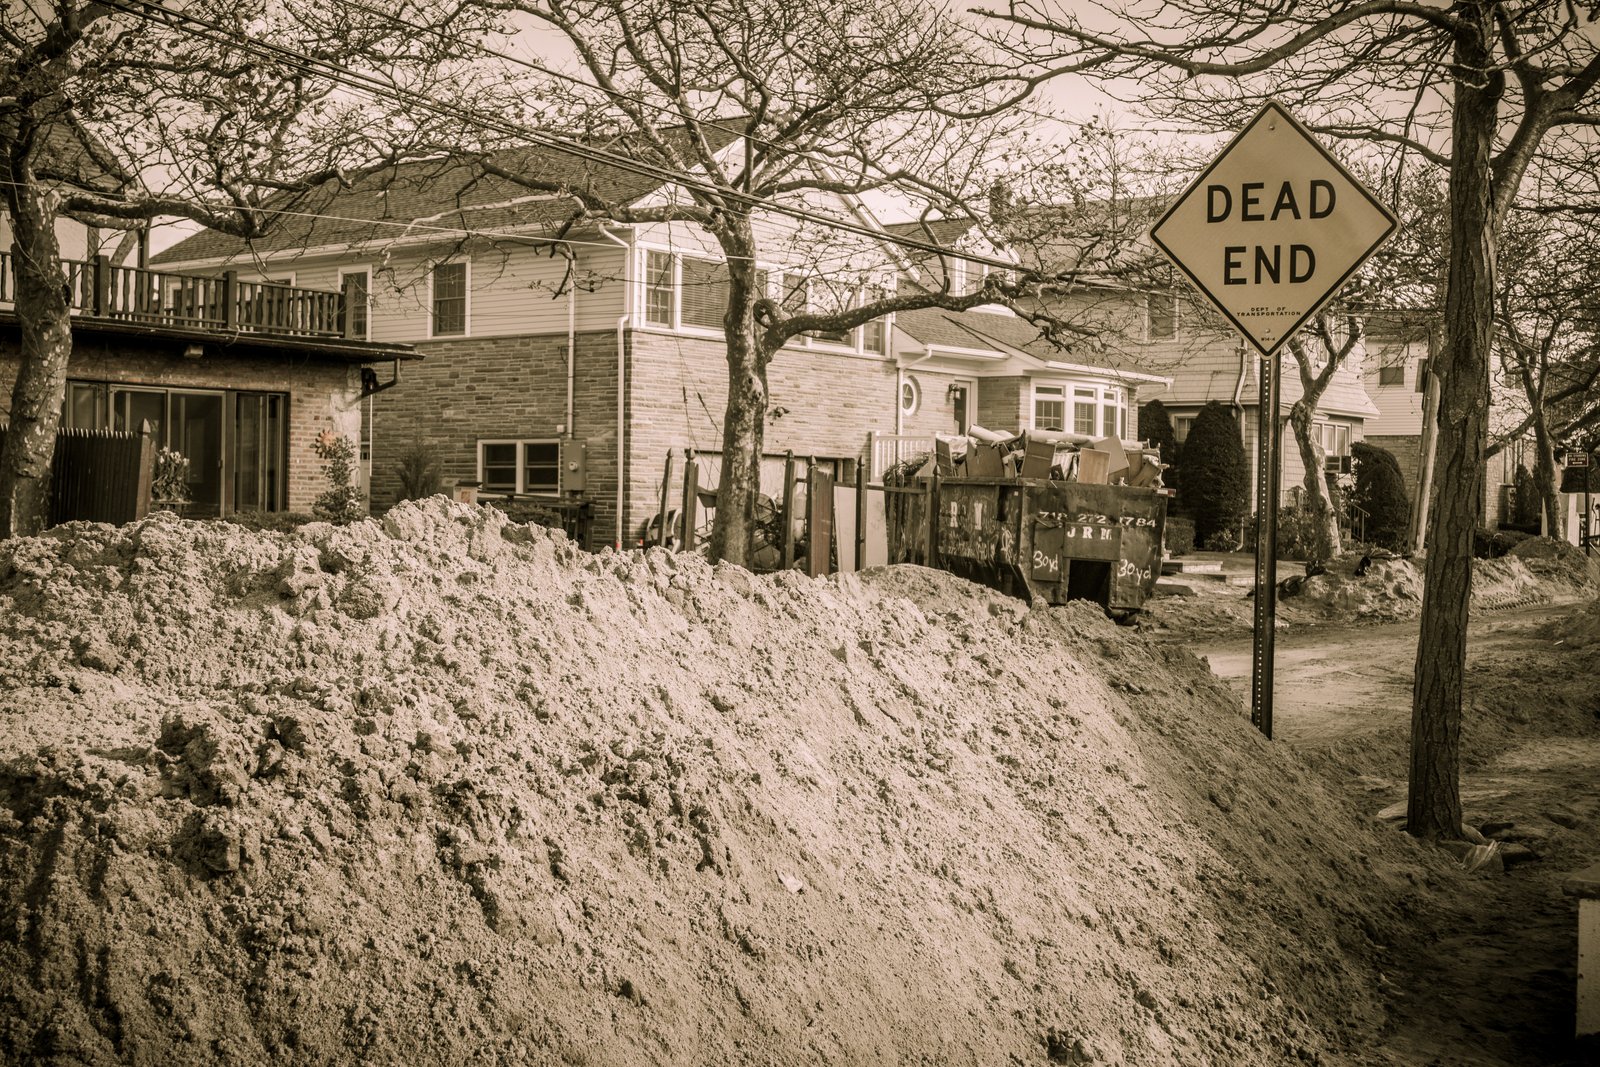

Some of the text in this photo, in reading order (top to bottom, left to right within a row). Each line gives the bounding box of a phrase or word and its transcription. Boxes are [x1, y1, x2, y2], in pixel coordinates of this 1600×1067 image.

[1207, 179, 1336, 223] DEAD
[1224, 244, 1316, 285] END
[1117, 559, 1151, 585] 30yd
